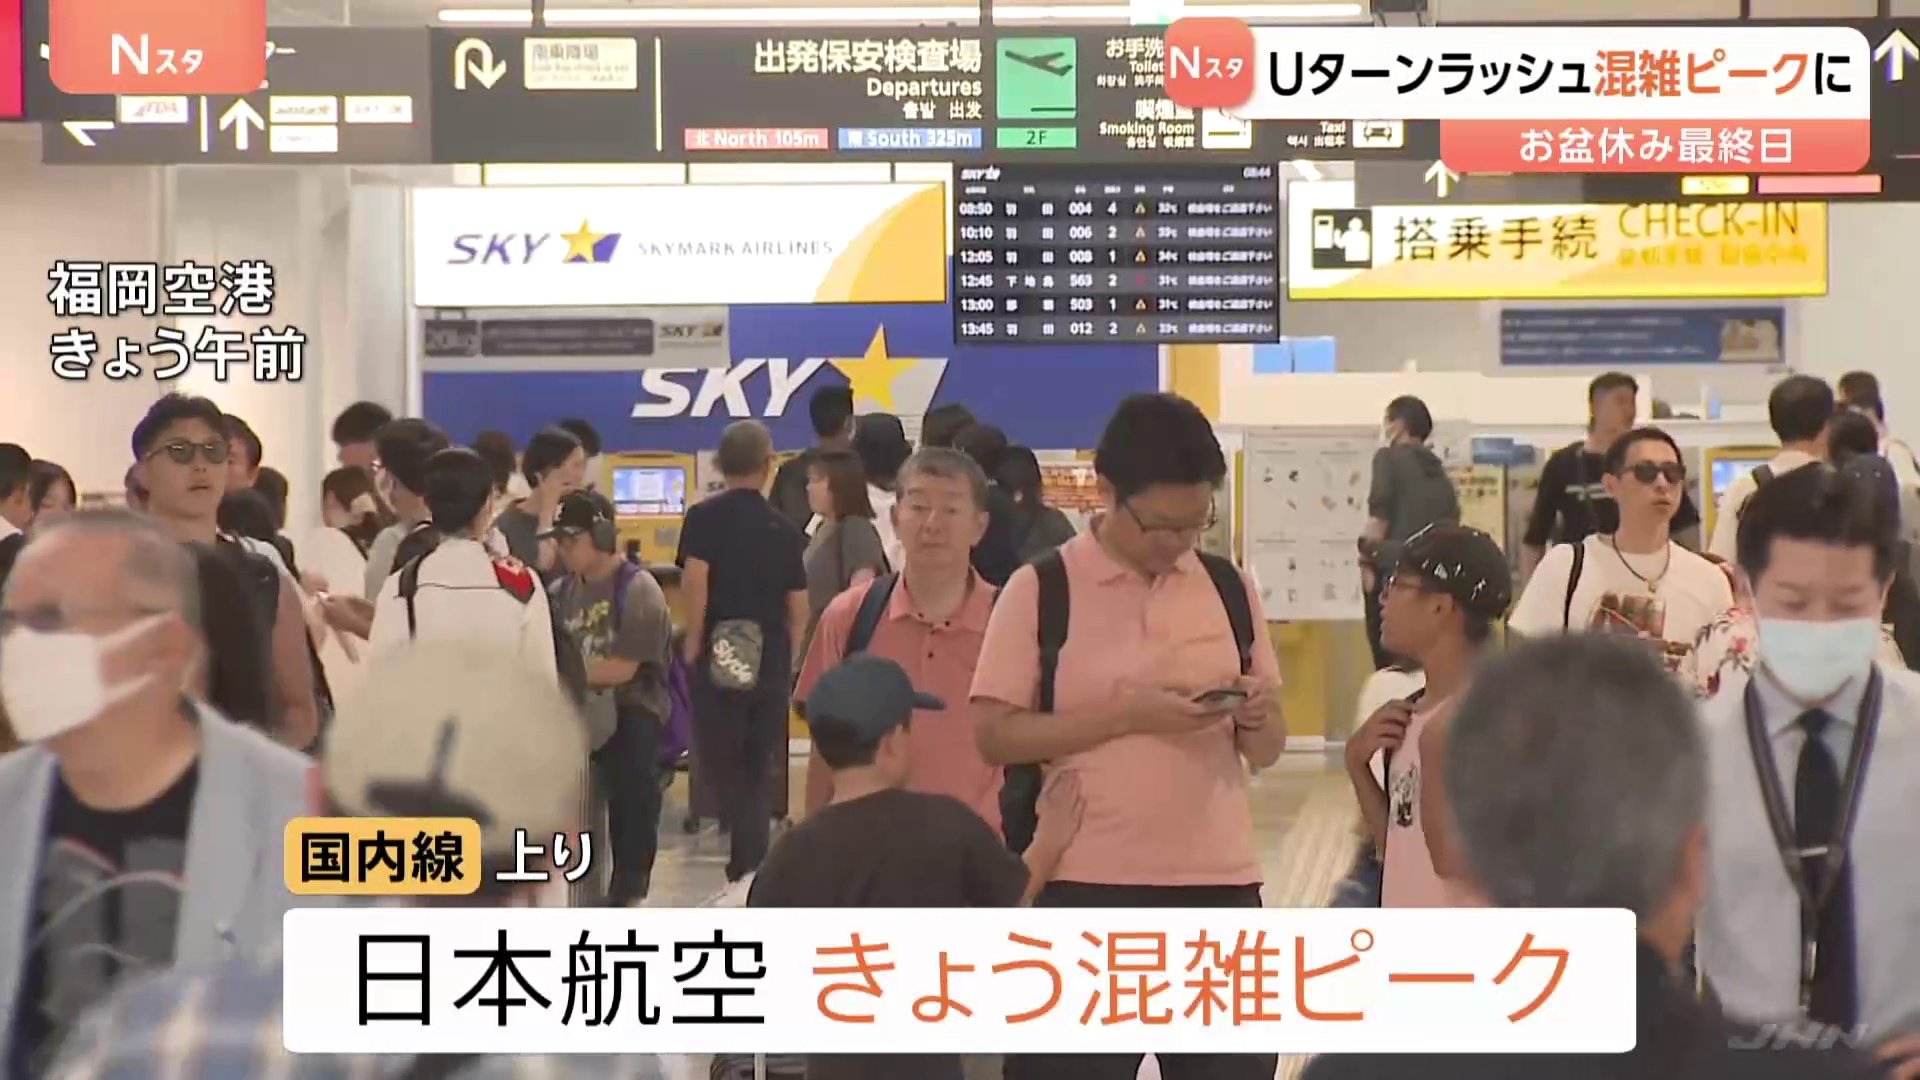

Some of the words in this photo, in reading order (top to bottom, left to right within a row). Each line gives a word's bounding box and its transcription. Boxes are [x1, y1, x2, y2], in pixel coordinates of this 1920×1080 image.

[754, 37, 983, 74] 出発保安検査場
[1129, 60, 1165, 74] Toilet
[866, 77, 983, 100] Departures
[1099, 120, 1157, 137] Smoking
[1158, 121, 1195, 135] Room
[1319, 121, 1346, 133] Taxi
[714, 129, 768, 147] North
[776, 129, 819, 147] 105m
[867, 129, 921, 147] South
[926, 129, 974, 147] 325m
[1026, 130, 1048, 145] 2F
[1068, 202, 1093, 216] 004
[1107, 202, 1118, 216] 4
[1617, 203, 1802, 239] CHECK-IN
[960, 226, 994, 240] 10:10
[1068, 226, 1093, 240] 006
[1107, 226, 1118, 240] 2
[1393, 214, 1598, 262] 搭乗手続
[447, 233, 552, 265] SKY
[637, 240, 736, 257] SKYMARK
[741, 240, 834, 256] AIRLINES
[960, 250, 994, 264] 12:05
[1068, 250, 1093, 264] 008
[1107, 250, 1118, 264] 1
[960, 274, 994, 288] 12:45
[1068, 274, 1093, 288] 563
[1107, 274, 1118, 288] 2
[960, 299, 994, 312] 13:00
[1068, 299, 1093, 312] 503
[1107, 299, 1118, 312] 1
[960, 322, 994, 336] 13:45
[1068, 322, 1093, 336] 012
[1107, 322, 1118, 336] 2
[631, 357, 829, 418] SKY
